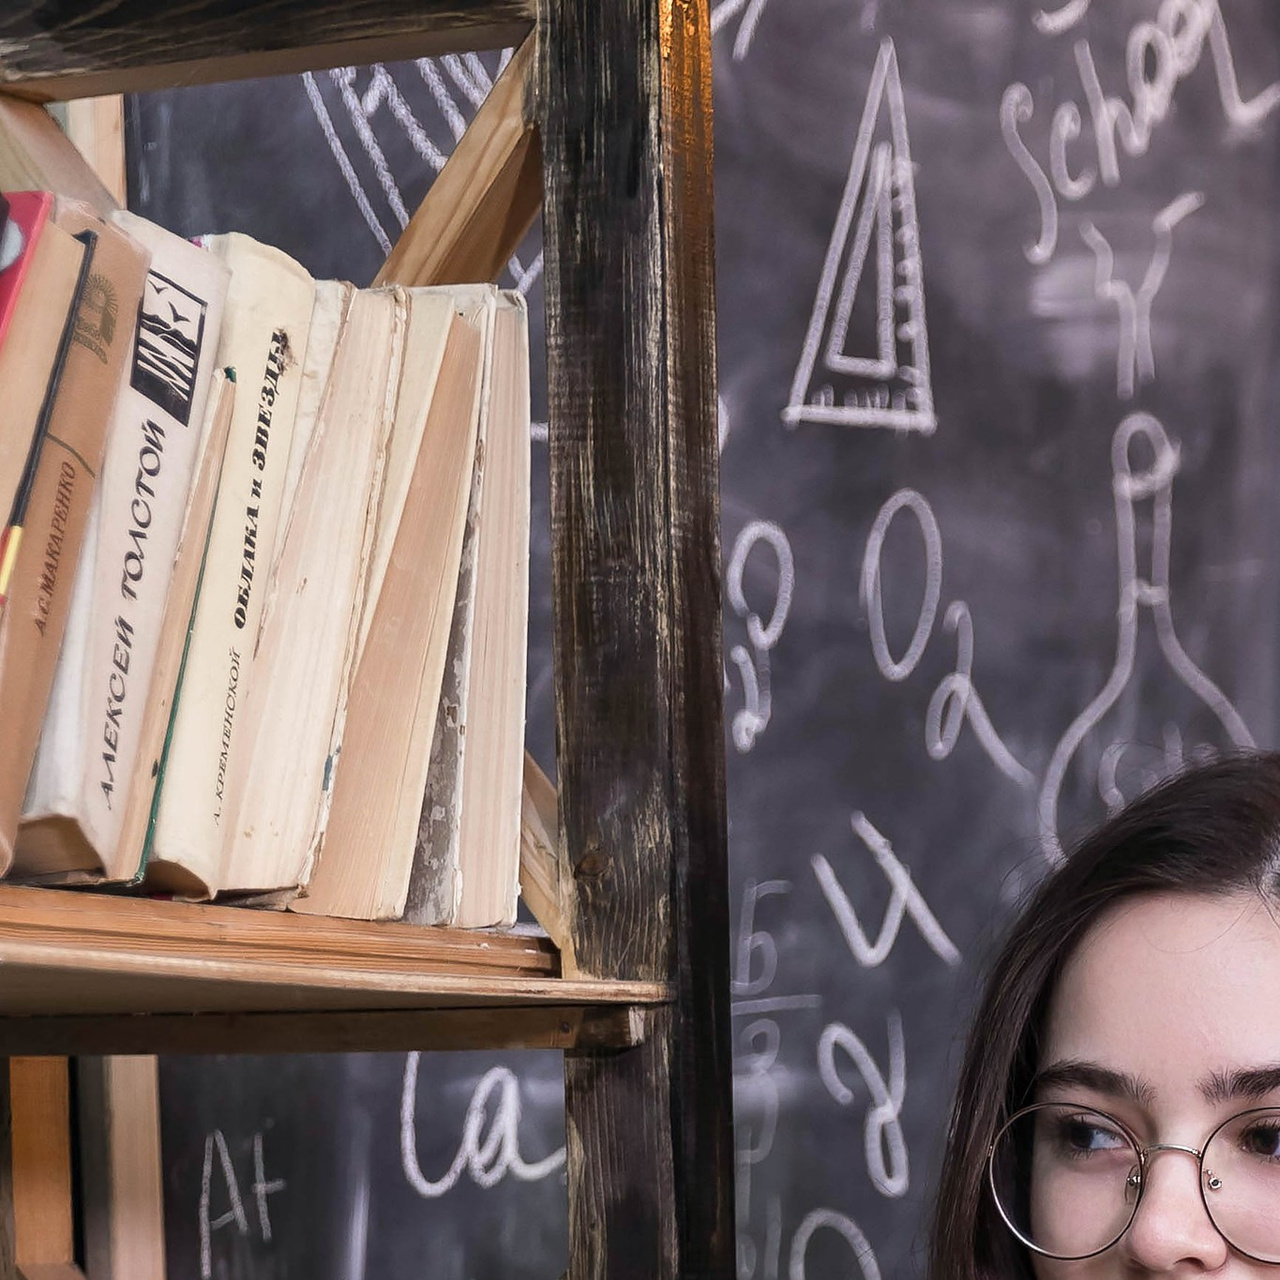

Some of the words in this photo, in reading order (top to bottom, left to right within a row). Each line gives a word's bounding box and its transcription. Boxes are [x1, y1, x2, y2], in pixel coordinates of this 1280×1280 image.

[101, 617, 139, 811] АЛЕКСЕЙ
[120, 419, 167, 602] ТОЛСТОЙ
[215, 648, 244, 799] КРЕМЕНСКОЙ
[233, 508, 260, 630] ОБЛАКА
[252, 329, 286, 468] ЗВЕЗДЫ
